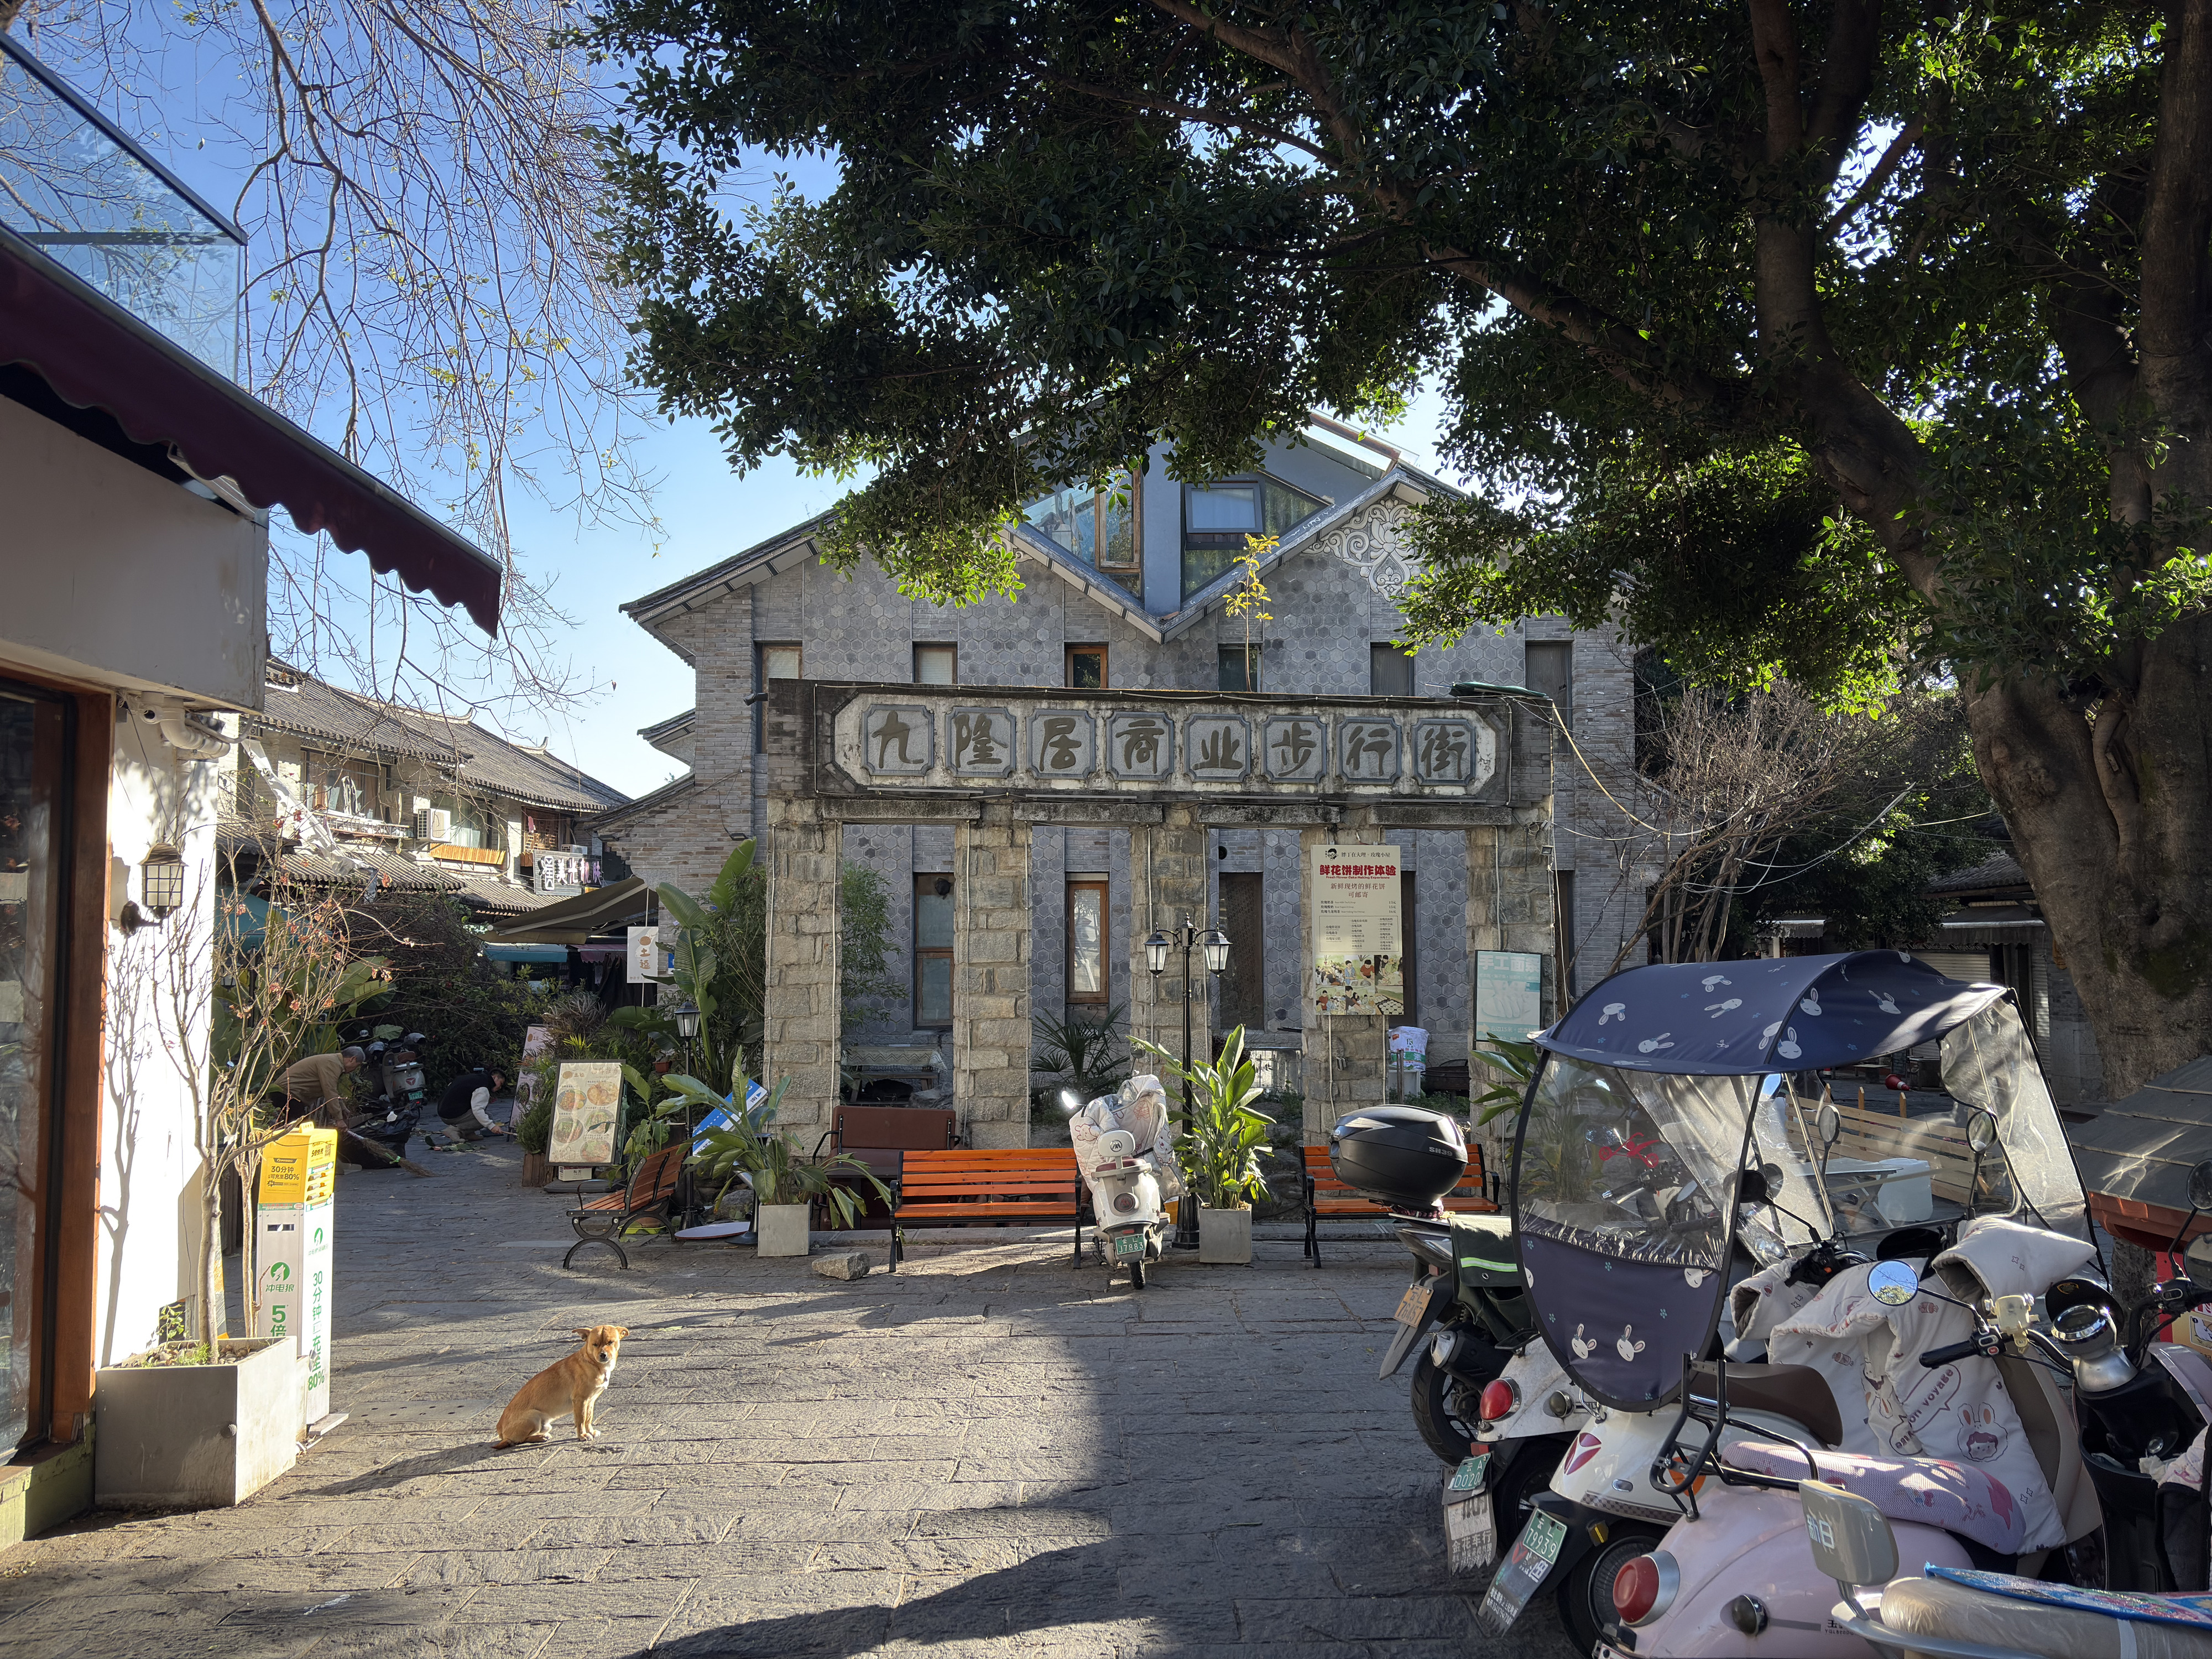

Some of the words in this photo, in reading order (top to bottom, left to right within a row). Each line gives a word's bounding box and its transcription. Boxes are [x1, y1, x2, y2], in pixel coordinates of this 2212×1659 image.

[872, 713, 1467, 776] 九隆居商业步行街
[1319, 864, 1396, 875] 鲜花饼制作体验
[1479, 954, 1540, 973] 手工面条
[1428, 1146, 1453, 1156] SH39
[1119, 1242, 1144, 1253] J7883
[265, 1284, 295, 1292] 冲电狼
[1452, 1530, 1492, 1553] 金花车行
[1526, 1528, 1557, 1558] 79939
